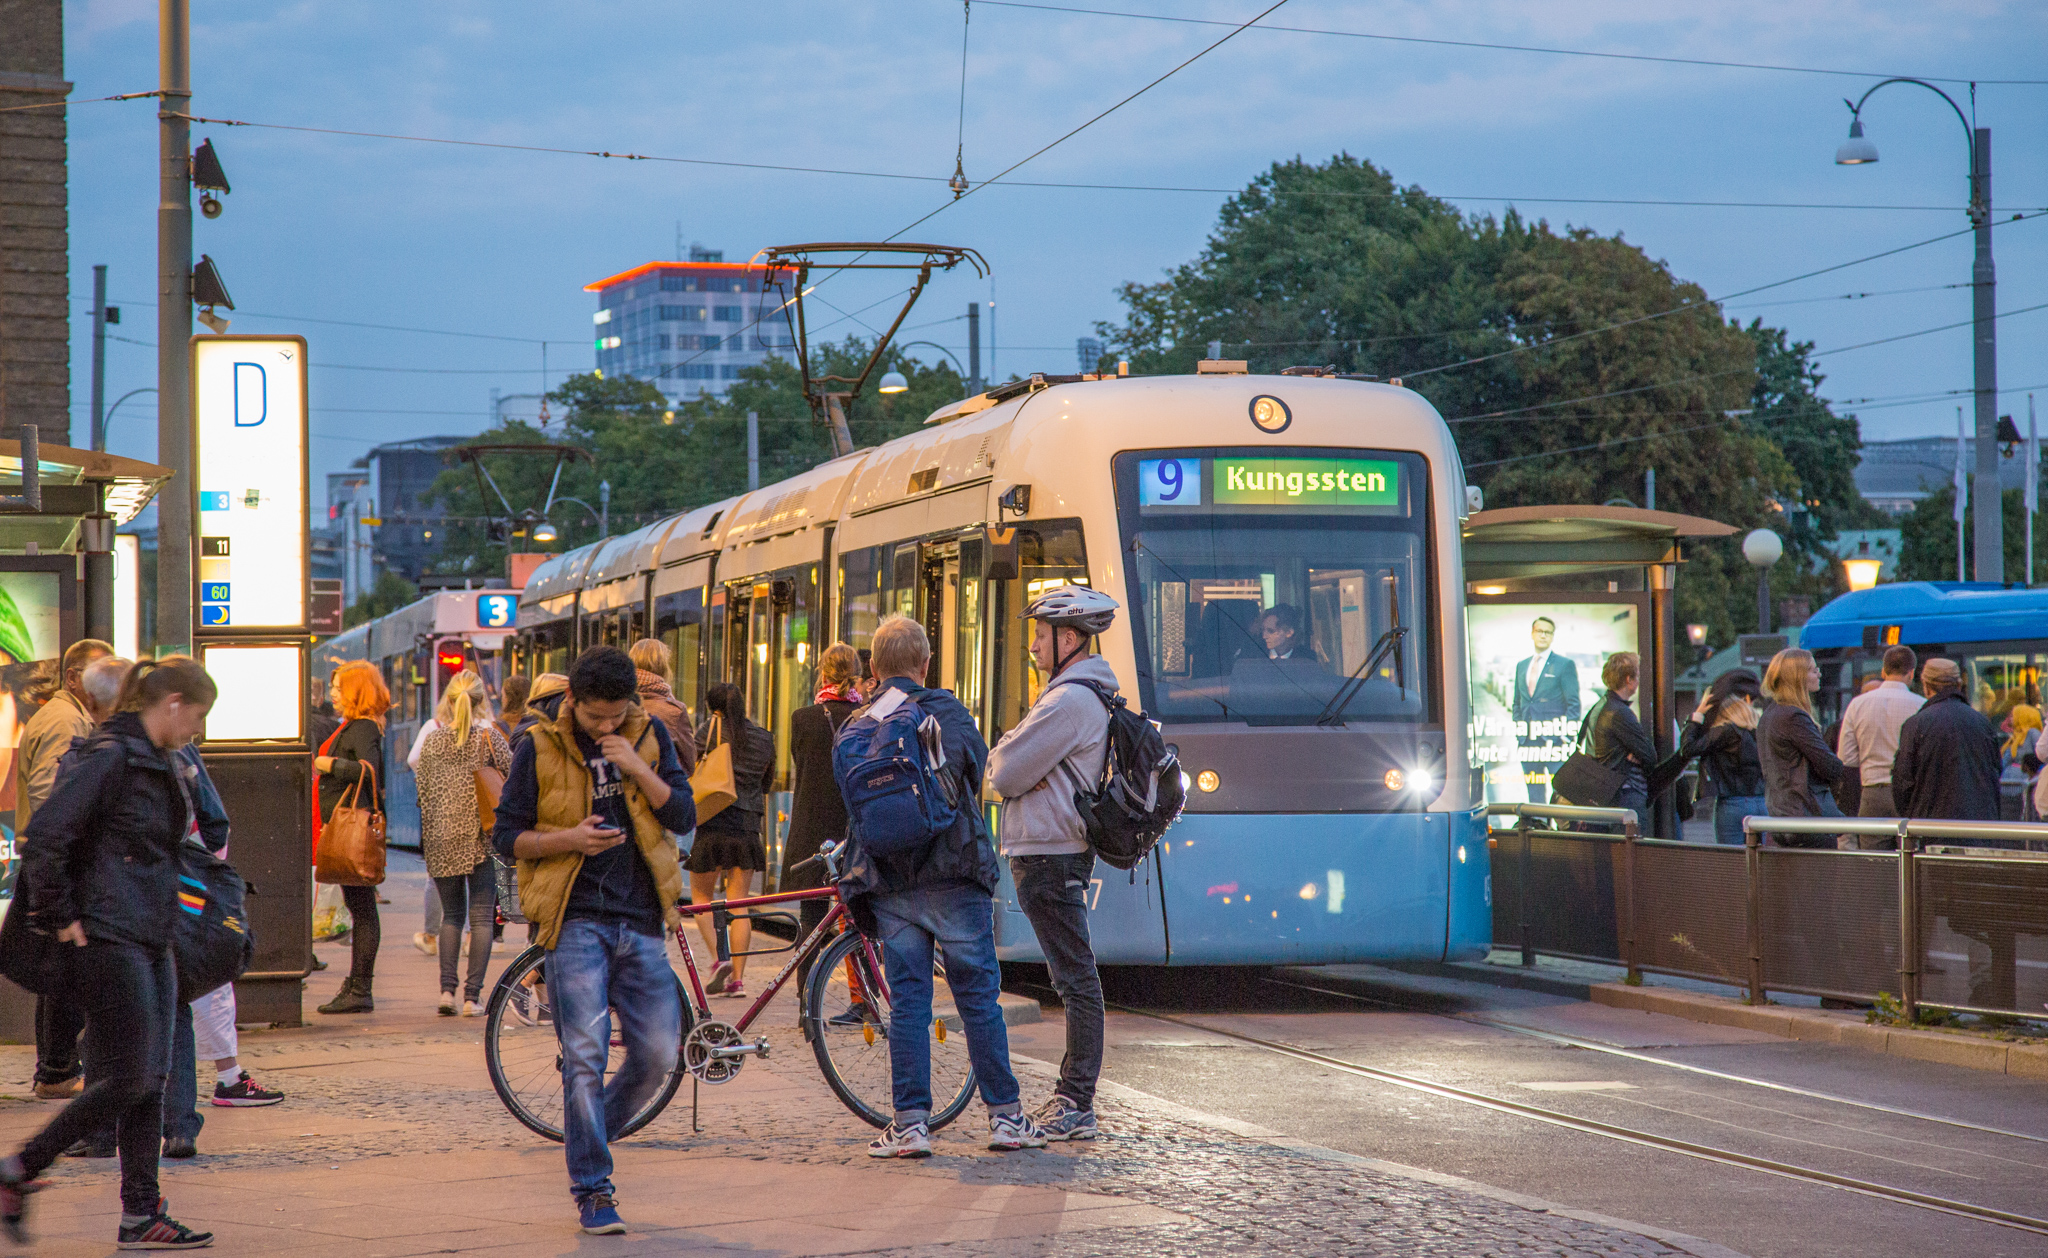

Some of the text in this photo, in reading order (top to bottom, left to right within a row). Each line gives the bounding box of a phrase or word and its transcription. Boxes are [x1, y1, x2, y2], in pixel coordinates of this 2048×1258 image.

[233, 362, 268, 427] D
[1157, 458, 1386, 501] 9 Kungssten
[218, 494, 228, 509] 3
[216, 540, 228, 554] 11
[211, 586, 228, 599] 60
[489, 596, 509, 626] 3
[677, 930, 693, 966] AVENUE
[775, 928, 822, 983] MONARK
